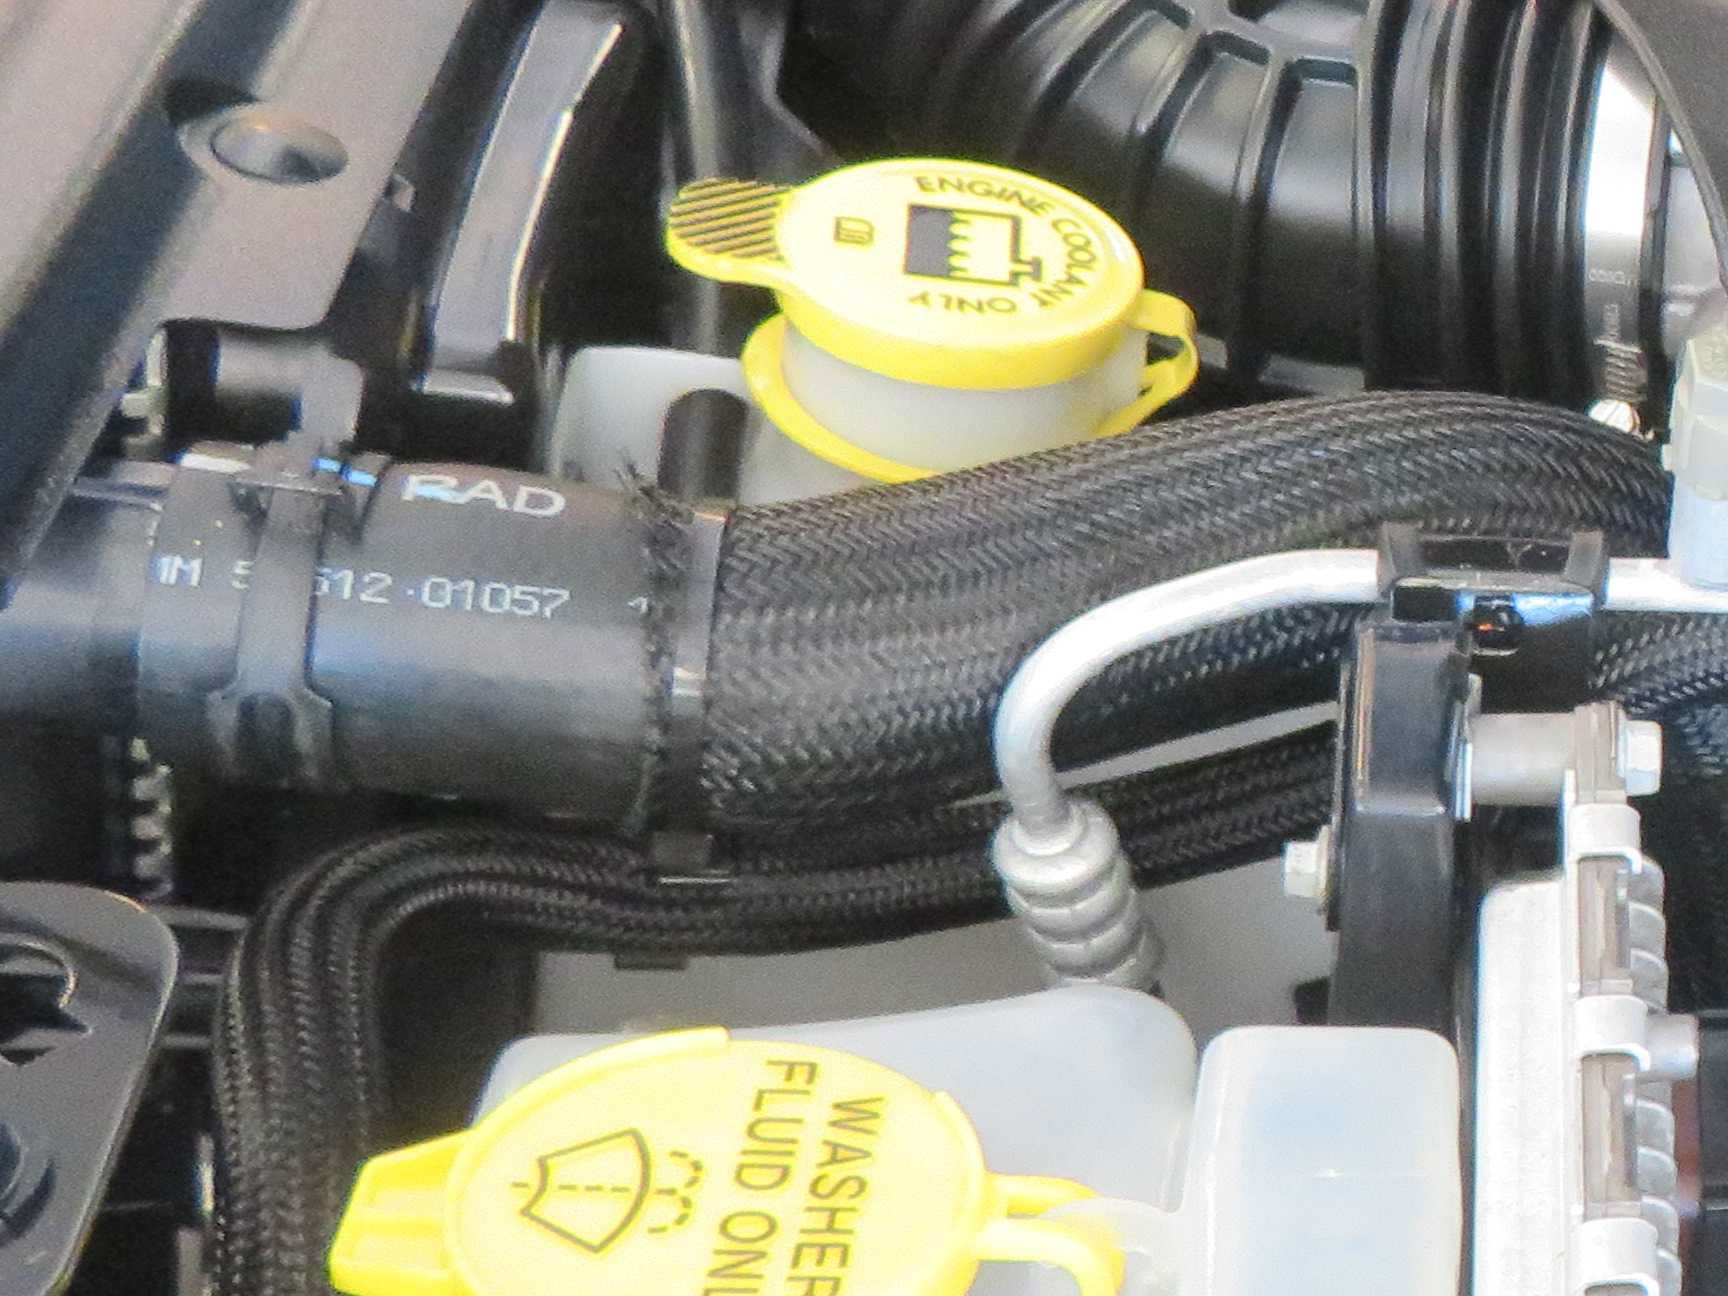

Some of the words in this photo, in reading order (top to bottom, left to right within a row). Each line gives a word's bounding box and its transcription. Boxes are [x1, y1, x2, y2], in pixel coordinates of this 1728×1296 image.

[913, 175, 1056, 217] ENGINE
[1027, 217, 1098, 309] COOLANT
[908, 290, 1018, 314] ONLY
[401, 473, 568, 517] RAD
[733, 1059, 819, 1192] FLUID
